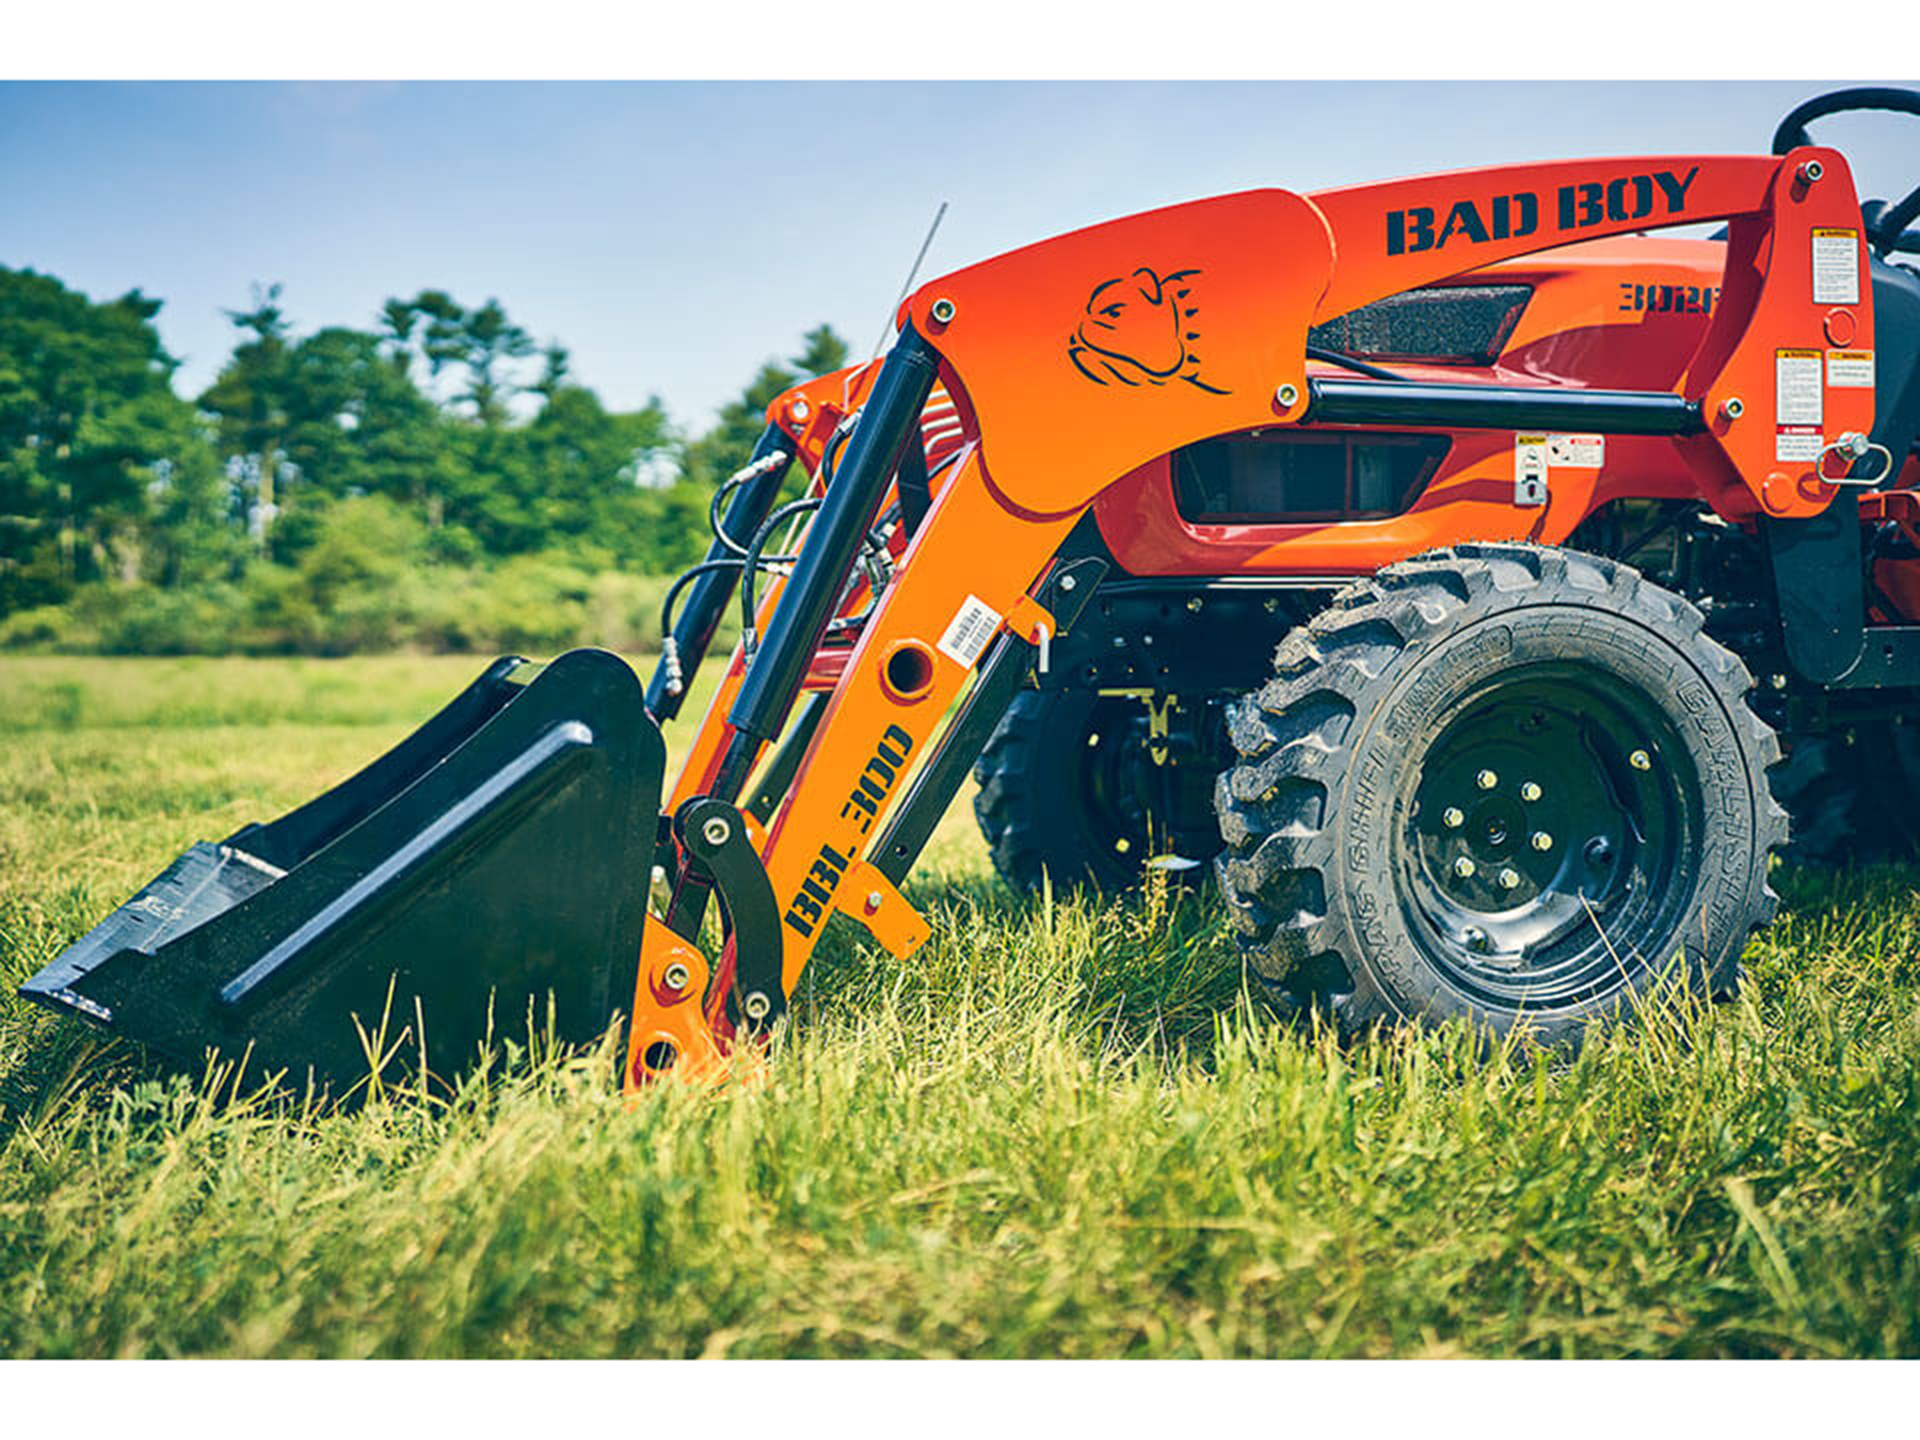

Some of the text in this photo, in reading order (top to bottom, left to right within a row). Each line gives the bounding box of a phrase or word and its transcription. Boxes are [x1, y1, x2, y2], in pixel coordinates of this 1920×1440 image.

[1387, 166, 1700, 256] BAD BOY
[784, 724, 914, 938] BBL 300
